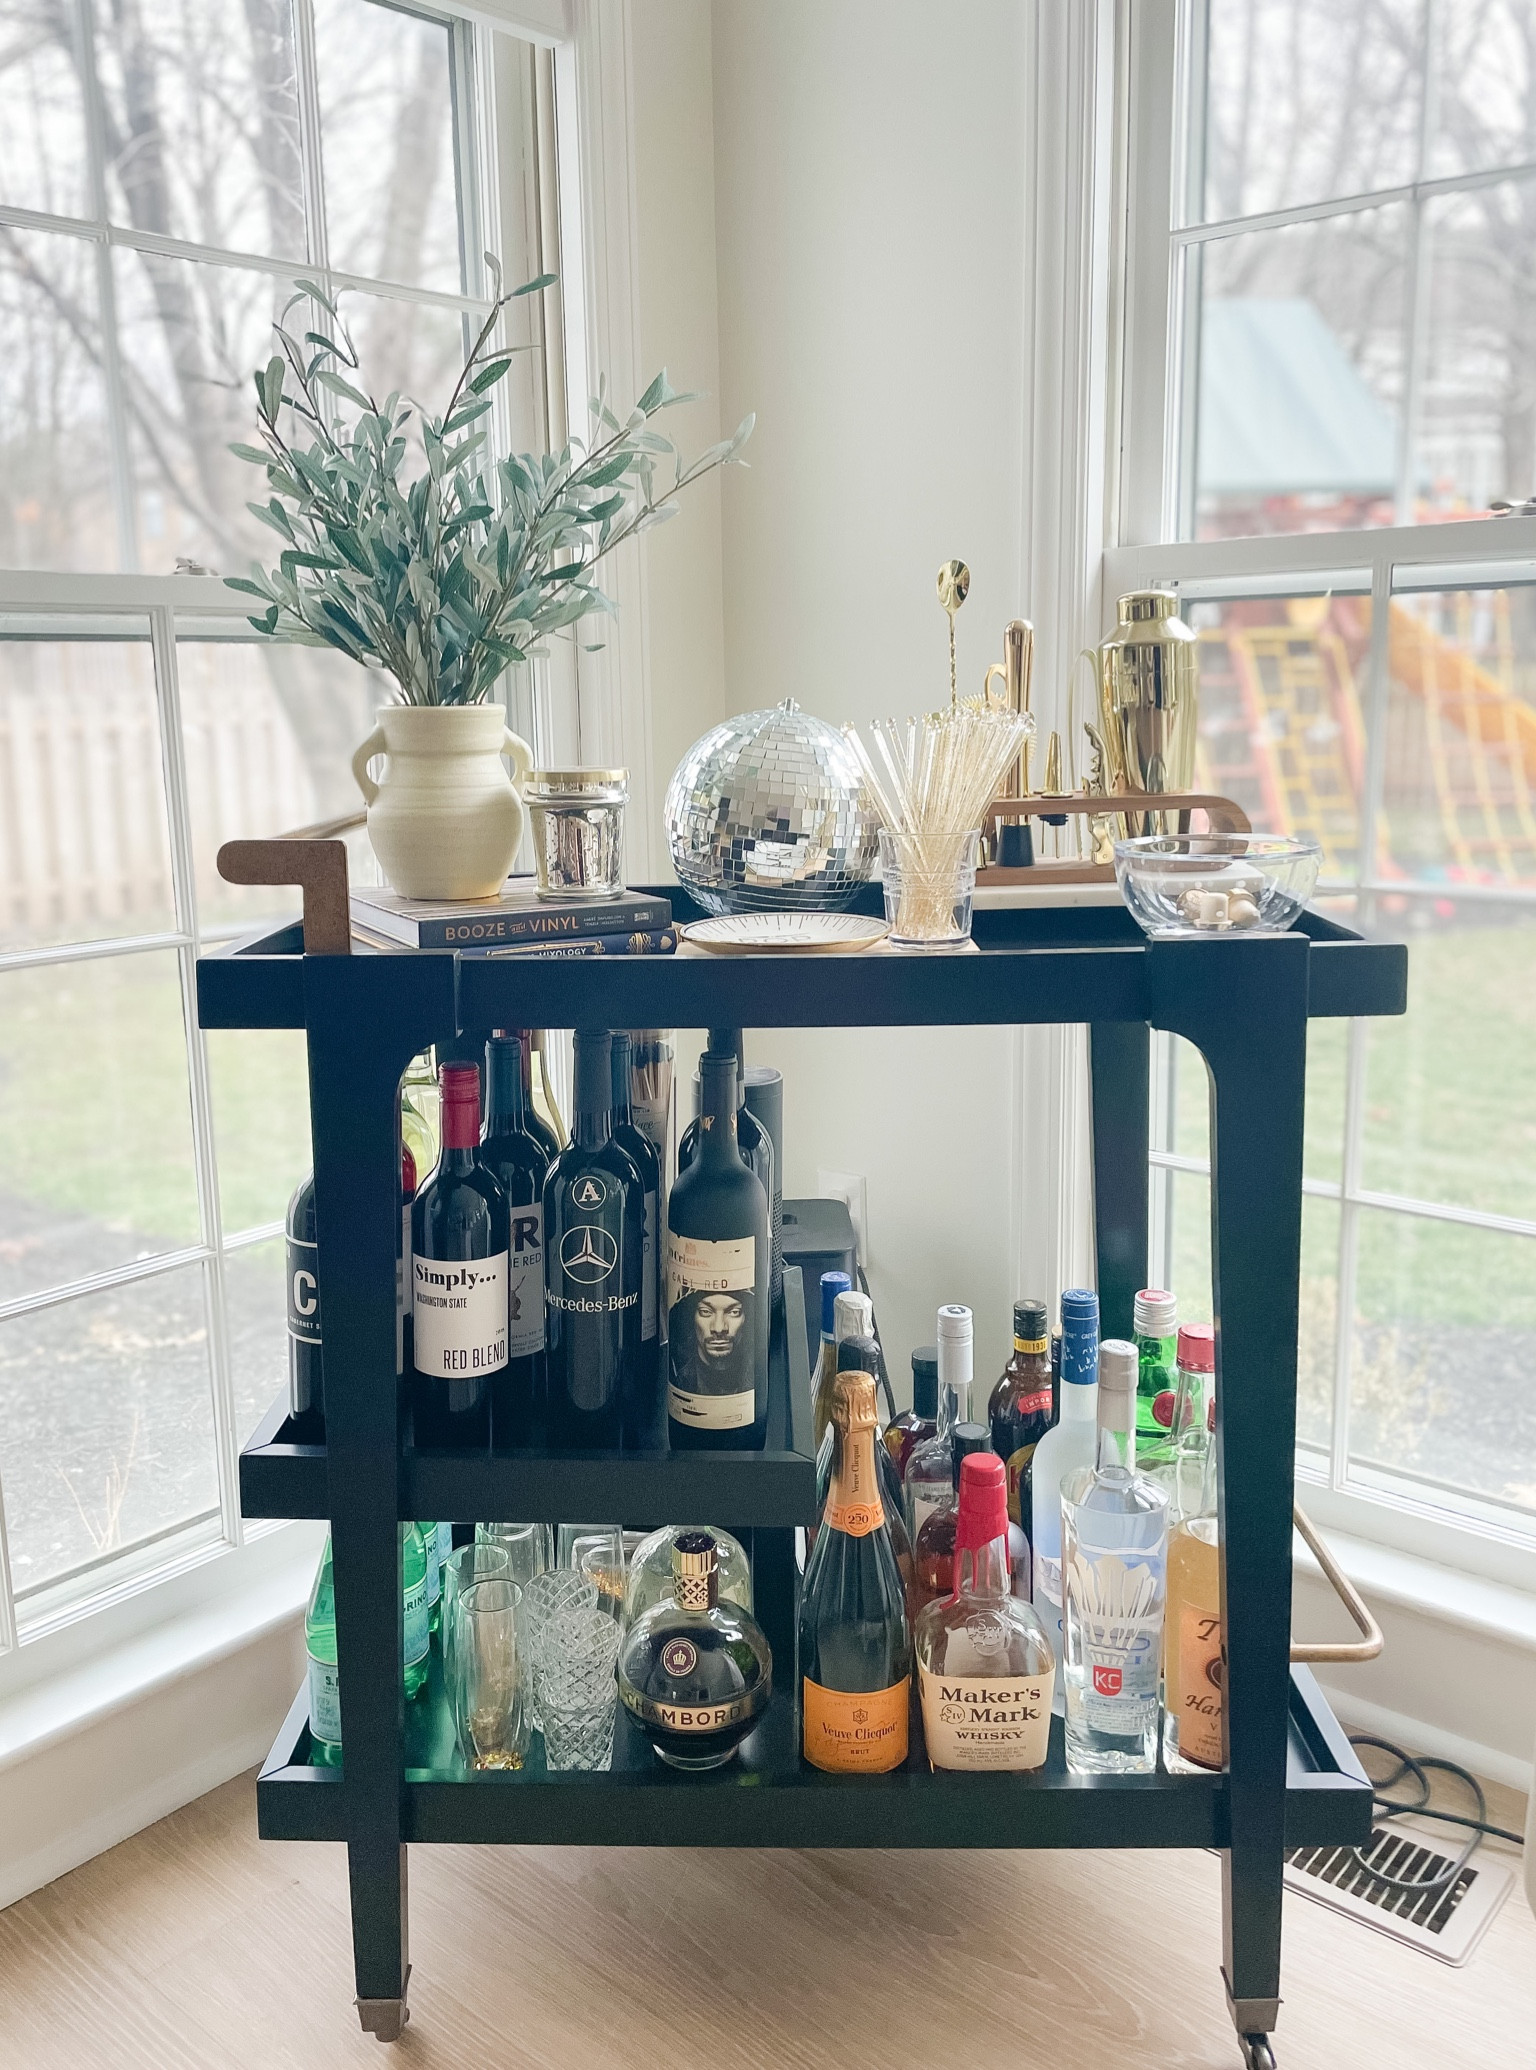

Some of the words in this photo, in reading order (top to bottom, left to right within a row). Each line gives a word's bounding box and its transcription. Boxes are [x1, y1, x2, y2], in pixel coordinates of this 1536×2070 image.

[445, 922, 506, 941] BOOZE
[509, 922, 527, 935] and
[528, 915, 580, 933] VINYL
[578, 1180, 602, 1203] A
[523, 1252, 542, 1267] RED
[415, 1263, 497, 1292] Simply...
[704, 1278, 728, 1290] RED
[293, 1269, 317, 1316] C
[416, 1292, 447, 1309] WASHINGTON
[448, 1297, 468, 1309] STATE
[544, 1285, 638, 1313] Mercedes-Benz
[443, 1349, 468, 1370] RED
[472, 1339, 505, 1369] BLEND
[404, 1590, 427, 1613] RINO
[1197, 1619, 1221, 1642] T
[1095, 1670, 1121, 1691] KC
[938, 1685, 1041, 1704] Maker's
[626, 1692, 741, 1726] CHAMBORD
[968, 1706, 1041, 1724] Mark
[822, 1721, 852, 1740] Veuve
[855, 1720, 898, 1740] Clicquot
[954, 1730, 1026, 1740] WHISKY
